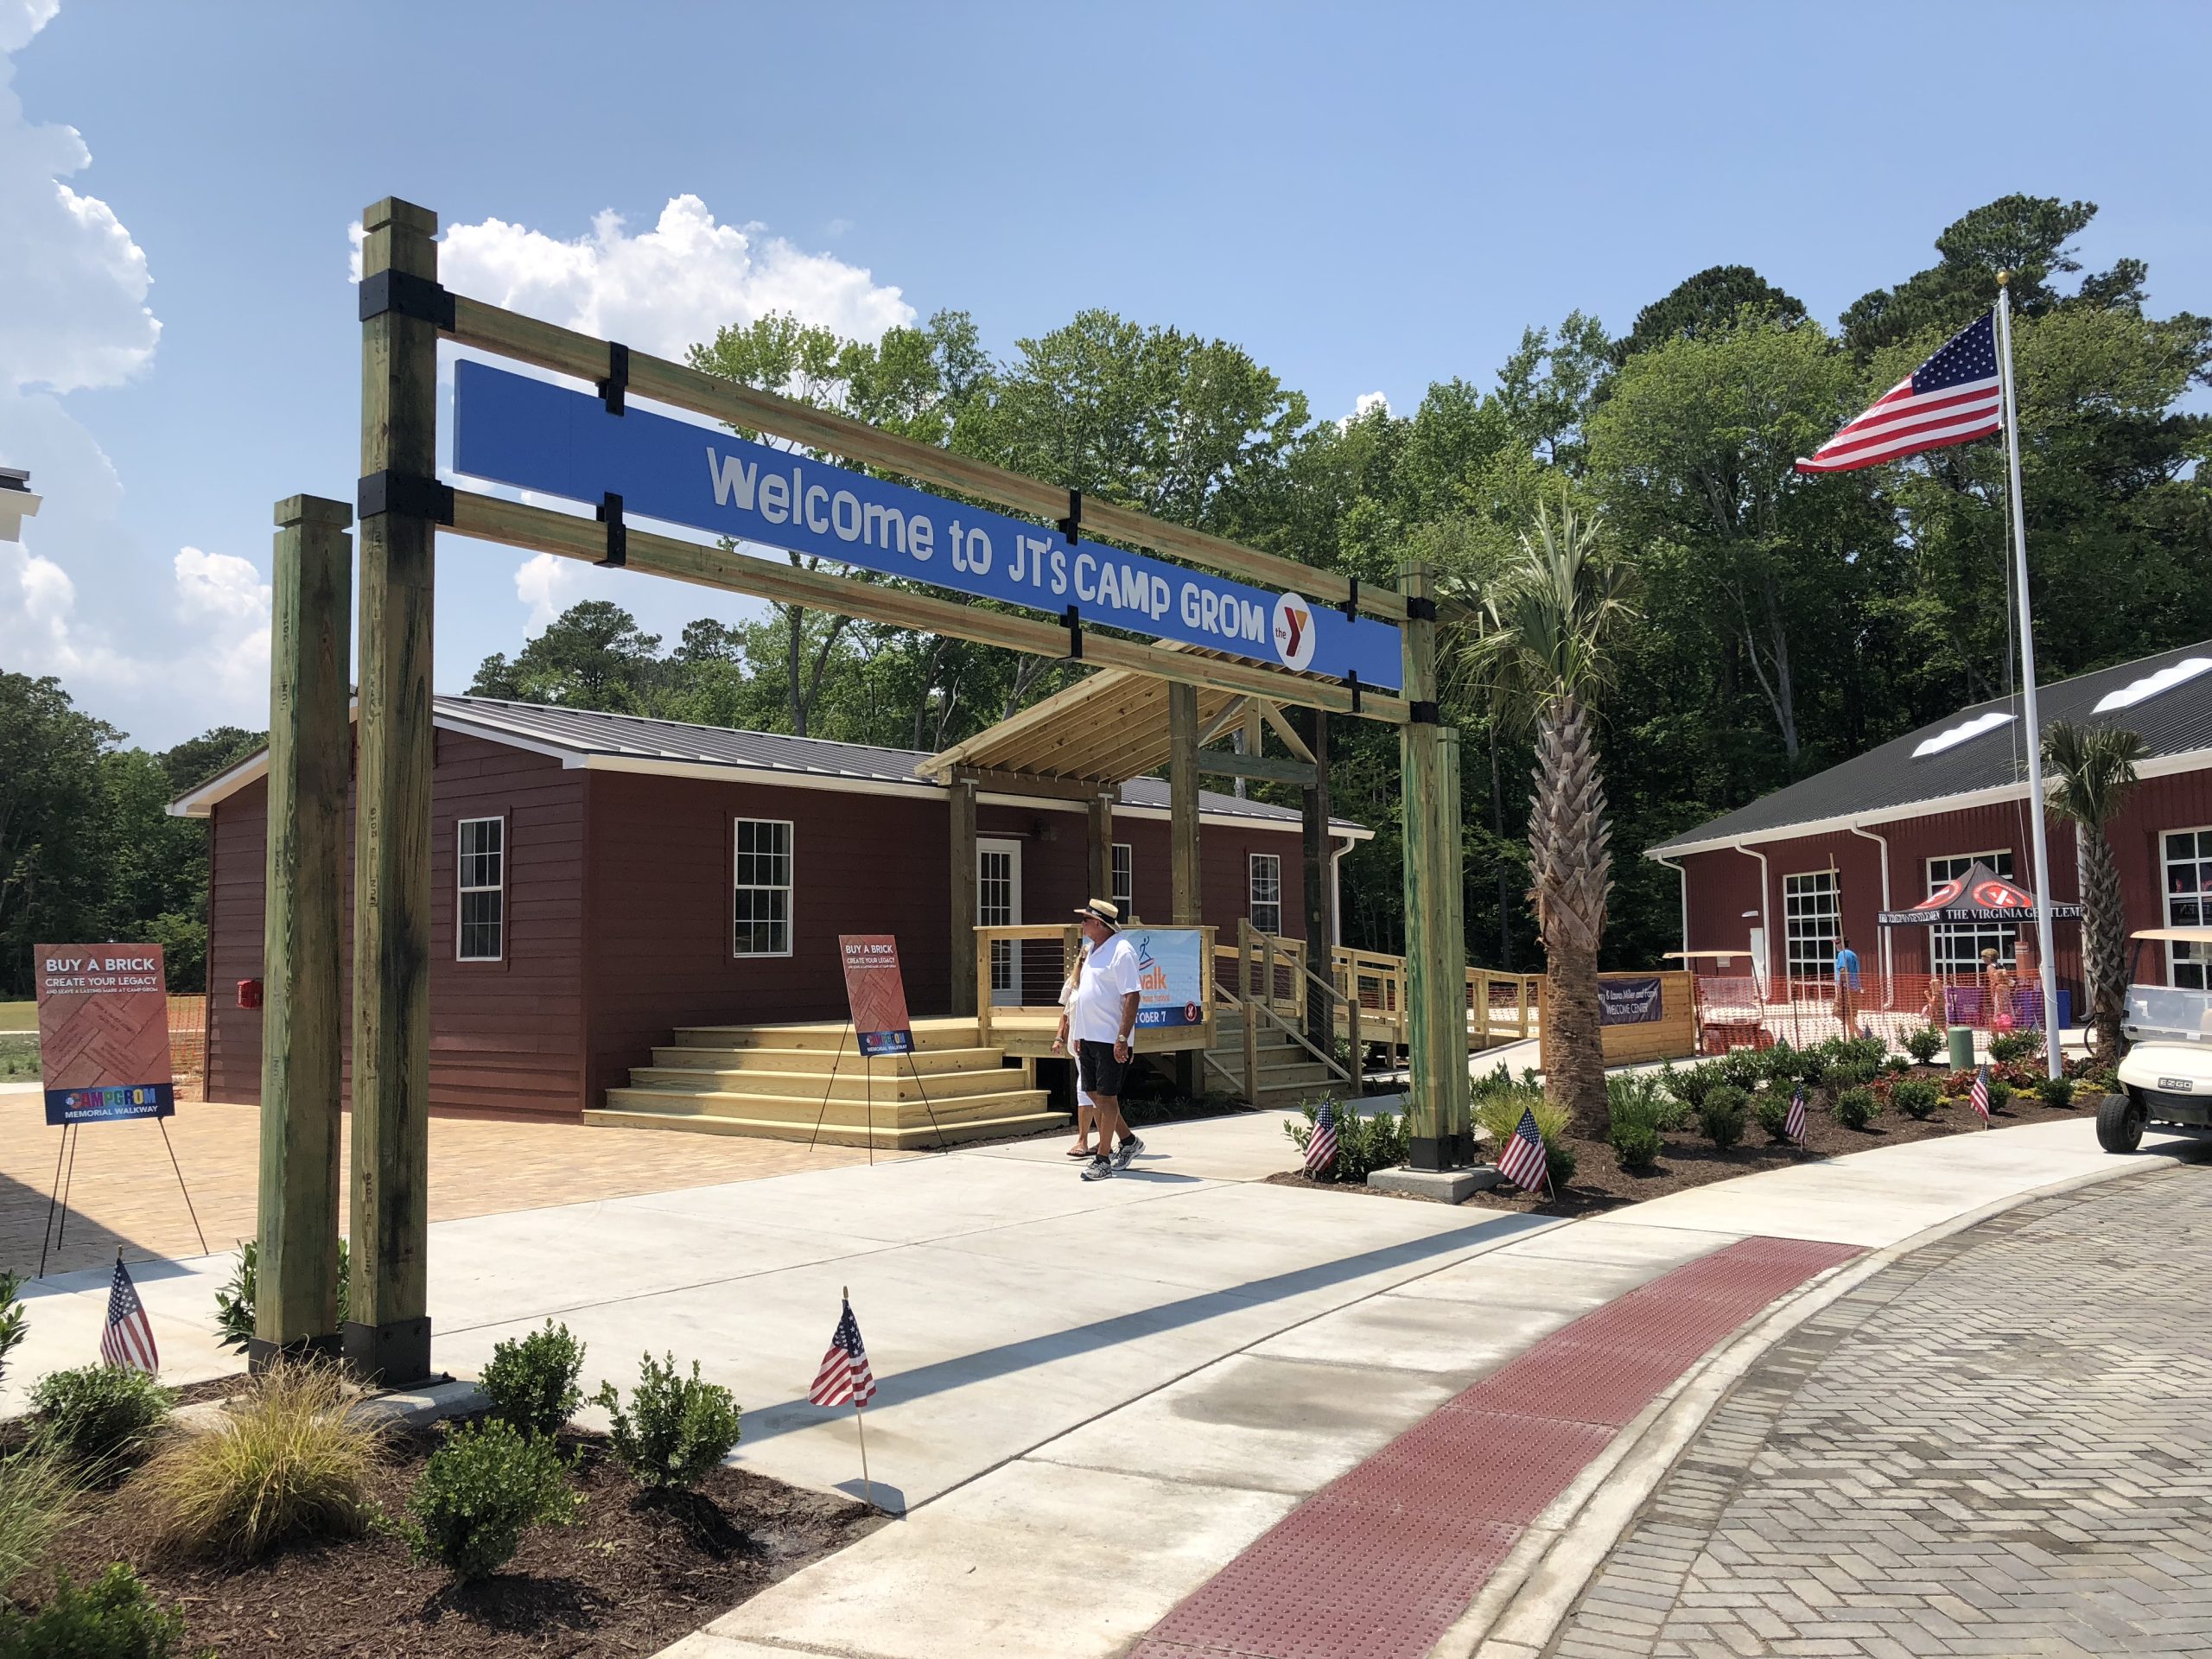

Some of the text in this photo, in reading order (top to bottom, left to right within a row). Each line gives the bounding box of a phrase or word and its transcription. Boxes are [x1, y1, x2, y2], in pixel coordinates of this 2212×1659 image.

[706, 447, 1266, 644] Welcome to JT's CAMP GROM
[1275, 626, 1287, 639] the
[1946, 907, 2083, 919] THE VIRGINIA GETLEM
[845, 944, 893, 954] BUY A BRICK
[46, 958, 156, 972] BUY A BRICK
[45, 976, 157, 987] CREATE YOUR LEGACY
[1623, 988, 1636, 1000] Miller
[1636, 988, 1644, 999] and
[1607, 1003, 1649, 1015] WELCOME CENTER
[1135, 1011, 1166, 1024] TOBER 7
[65, 1105, 158, 1119] MEMORIAL WALKWAY
